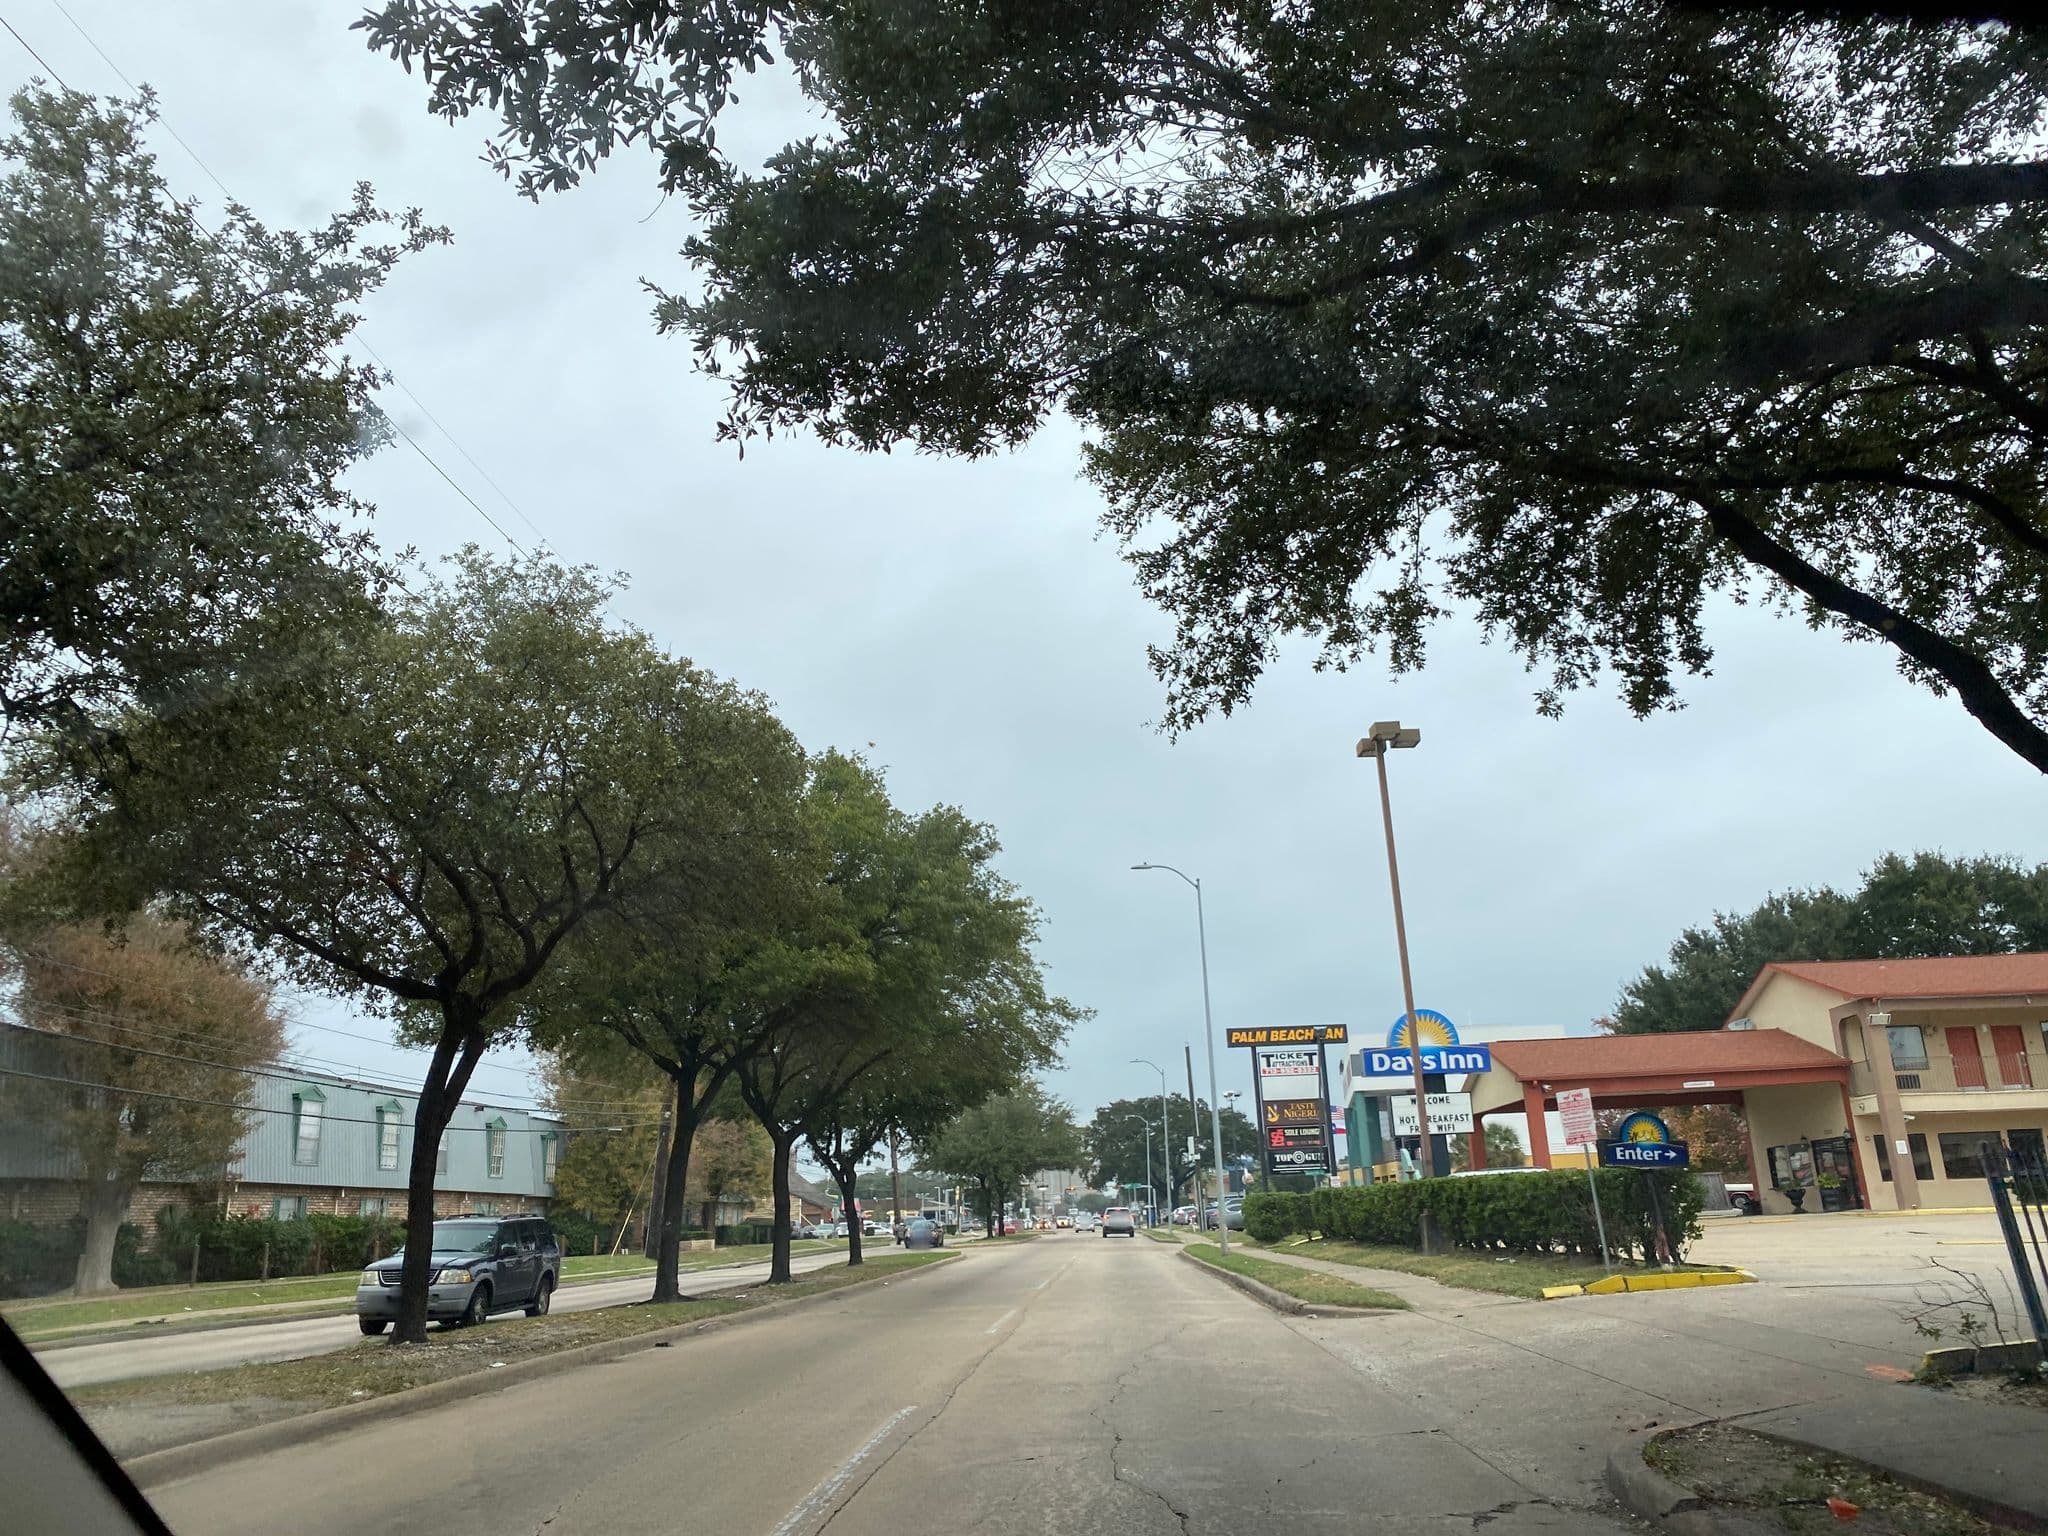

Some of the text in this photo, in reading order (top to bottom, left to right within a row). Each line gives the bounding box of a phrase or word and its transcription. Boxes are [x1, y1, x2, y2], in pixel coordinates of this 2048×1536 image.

[1231, 1027, 1344, 1043] PALM BEACH AN
[1261, 1052, 1317, 1067] TICKET
[1440, 1050, 1484, 1069] Inn
[1410, 1096, 1451, 1105] WCOME
[1399, 1114, 1470, 1124] HOT REAKFAST
[1436, 1124, 1456, 1132] WIFI
[1274, 1153, 1293, 1162] TOP
[1615, 1147, 1662, 1161] Enter
